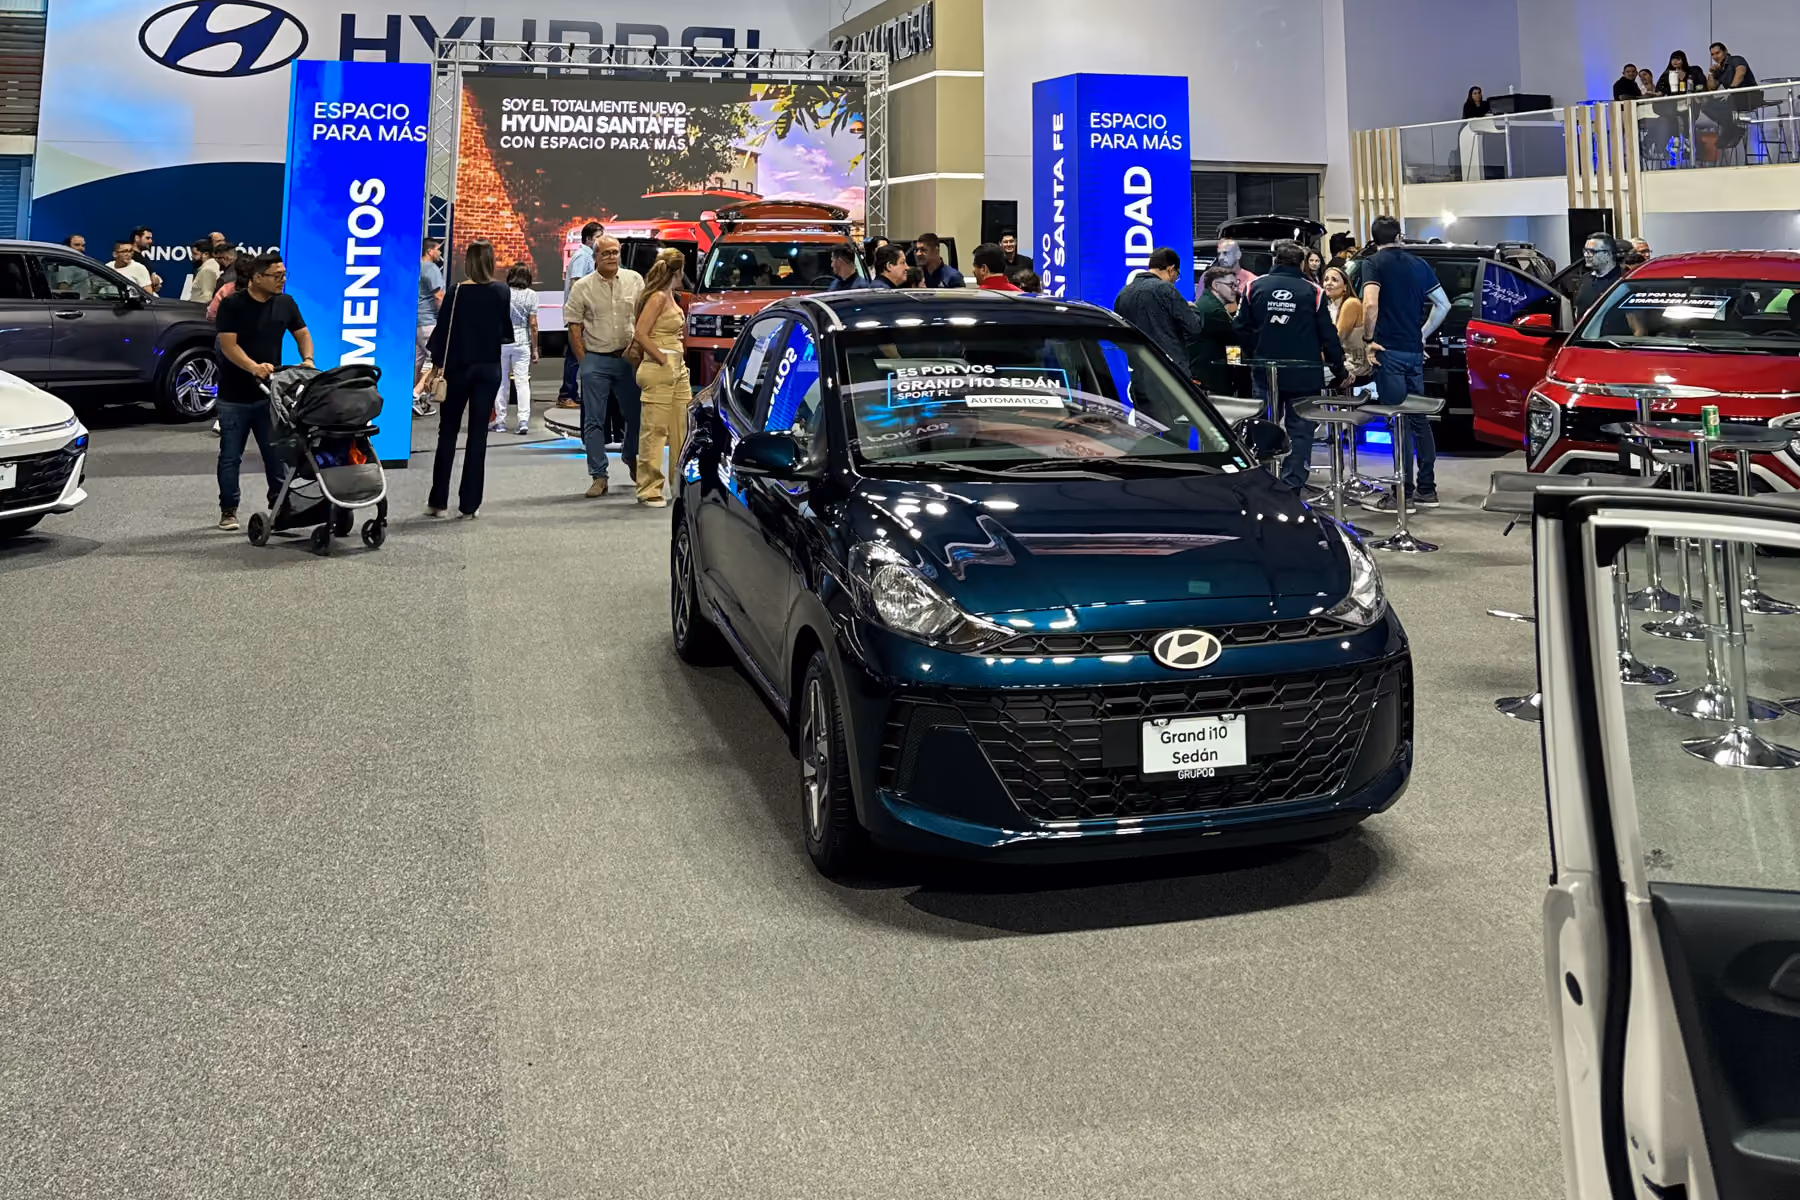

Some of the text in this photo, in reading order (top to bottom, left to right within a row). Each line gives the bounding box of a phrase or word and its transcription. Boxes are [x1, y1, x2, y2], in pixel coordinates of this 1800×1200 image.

[314, 102, 409, 120] ESPACIO
[502, 98, 686, 115] SOY EL TOTALMENTE NUEVO
[501, 114, 687, 135] HYUNDAI SANTA FE
[1090, 112, 1167, 129] ESPACIO
[312, 120, 426, 142] PARA MÁS
[1053, 113, 1064, 151] FE
[1091, 130, 1182, 150] PARA MÁS
[500, 135, 686, 150] CON ESPACIO PARA MÁS
[1053, 158, 1065, 268] SANTA
[896, 364, 995, 379] ES POR VOS
[896, 378, 964, 393] GRAND
[1000, 375, 1060, 390] SEDÁN
[897, 389, 951, 400] SPORT FL
[1160, 726, 1228, 744] Grand i10
[1172, 749, 1218, 764] Sedán
